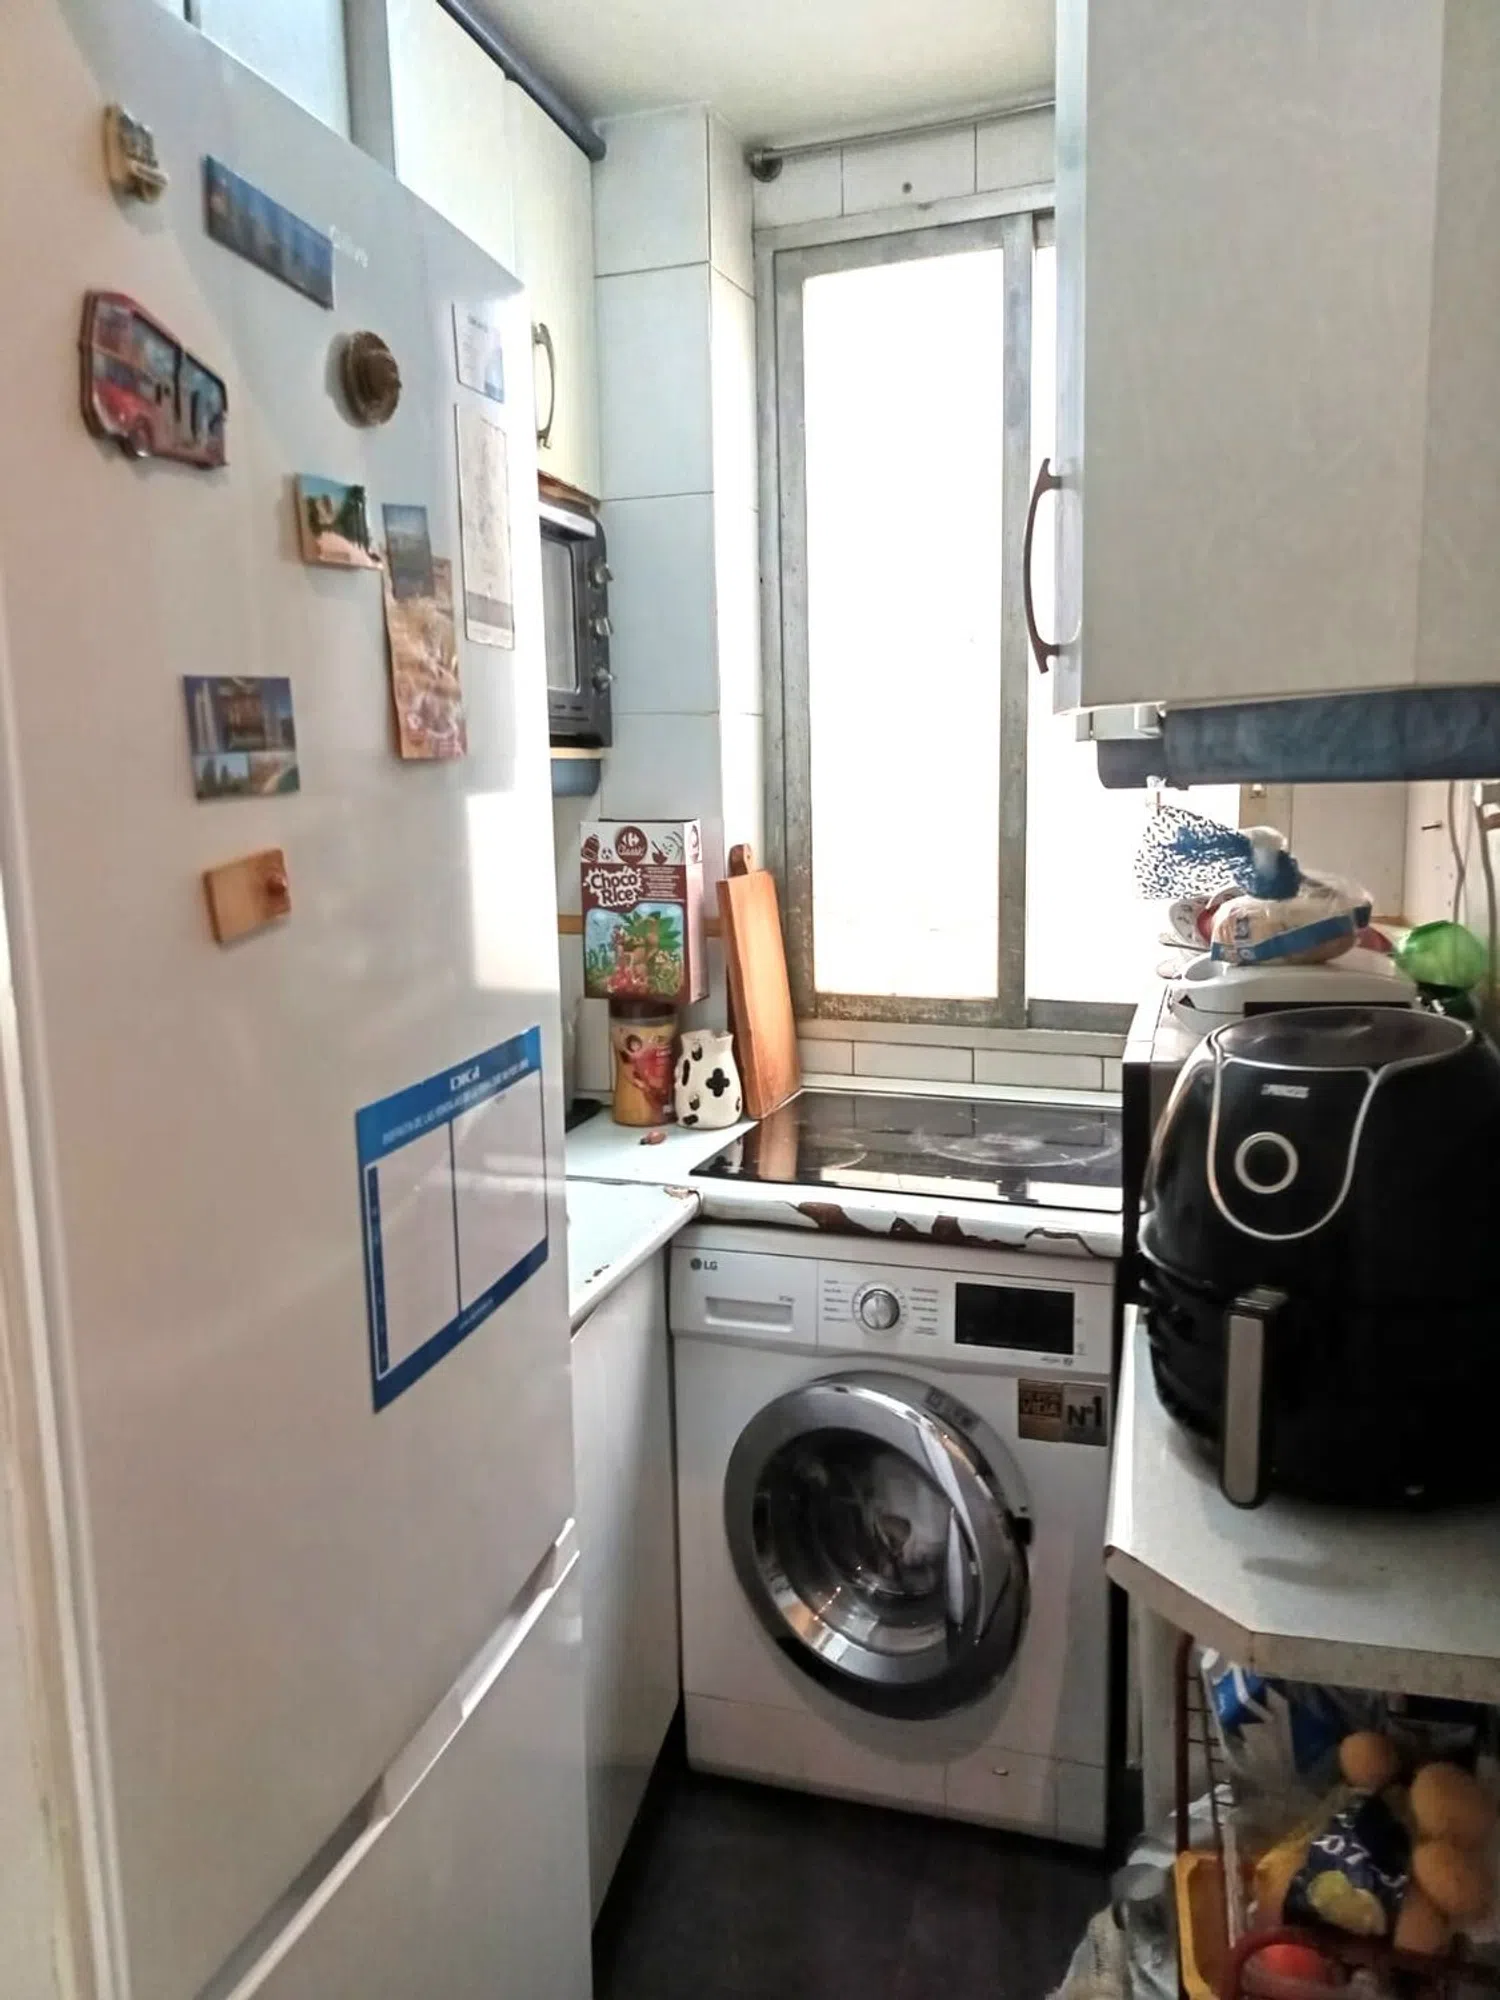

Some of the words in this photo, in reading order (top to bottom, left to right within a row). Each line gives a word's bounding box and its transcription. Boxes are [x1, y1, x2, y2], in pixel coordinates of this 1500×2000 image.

[591, 874, 637, 892] Choco
[601, 888, 633, 904] Rice
[450, 1065, 480, 1091] DIGI
[704, 1260, 718, 1271] LG
